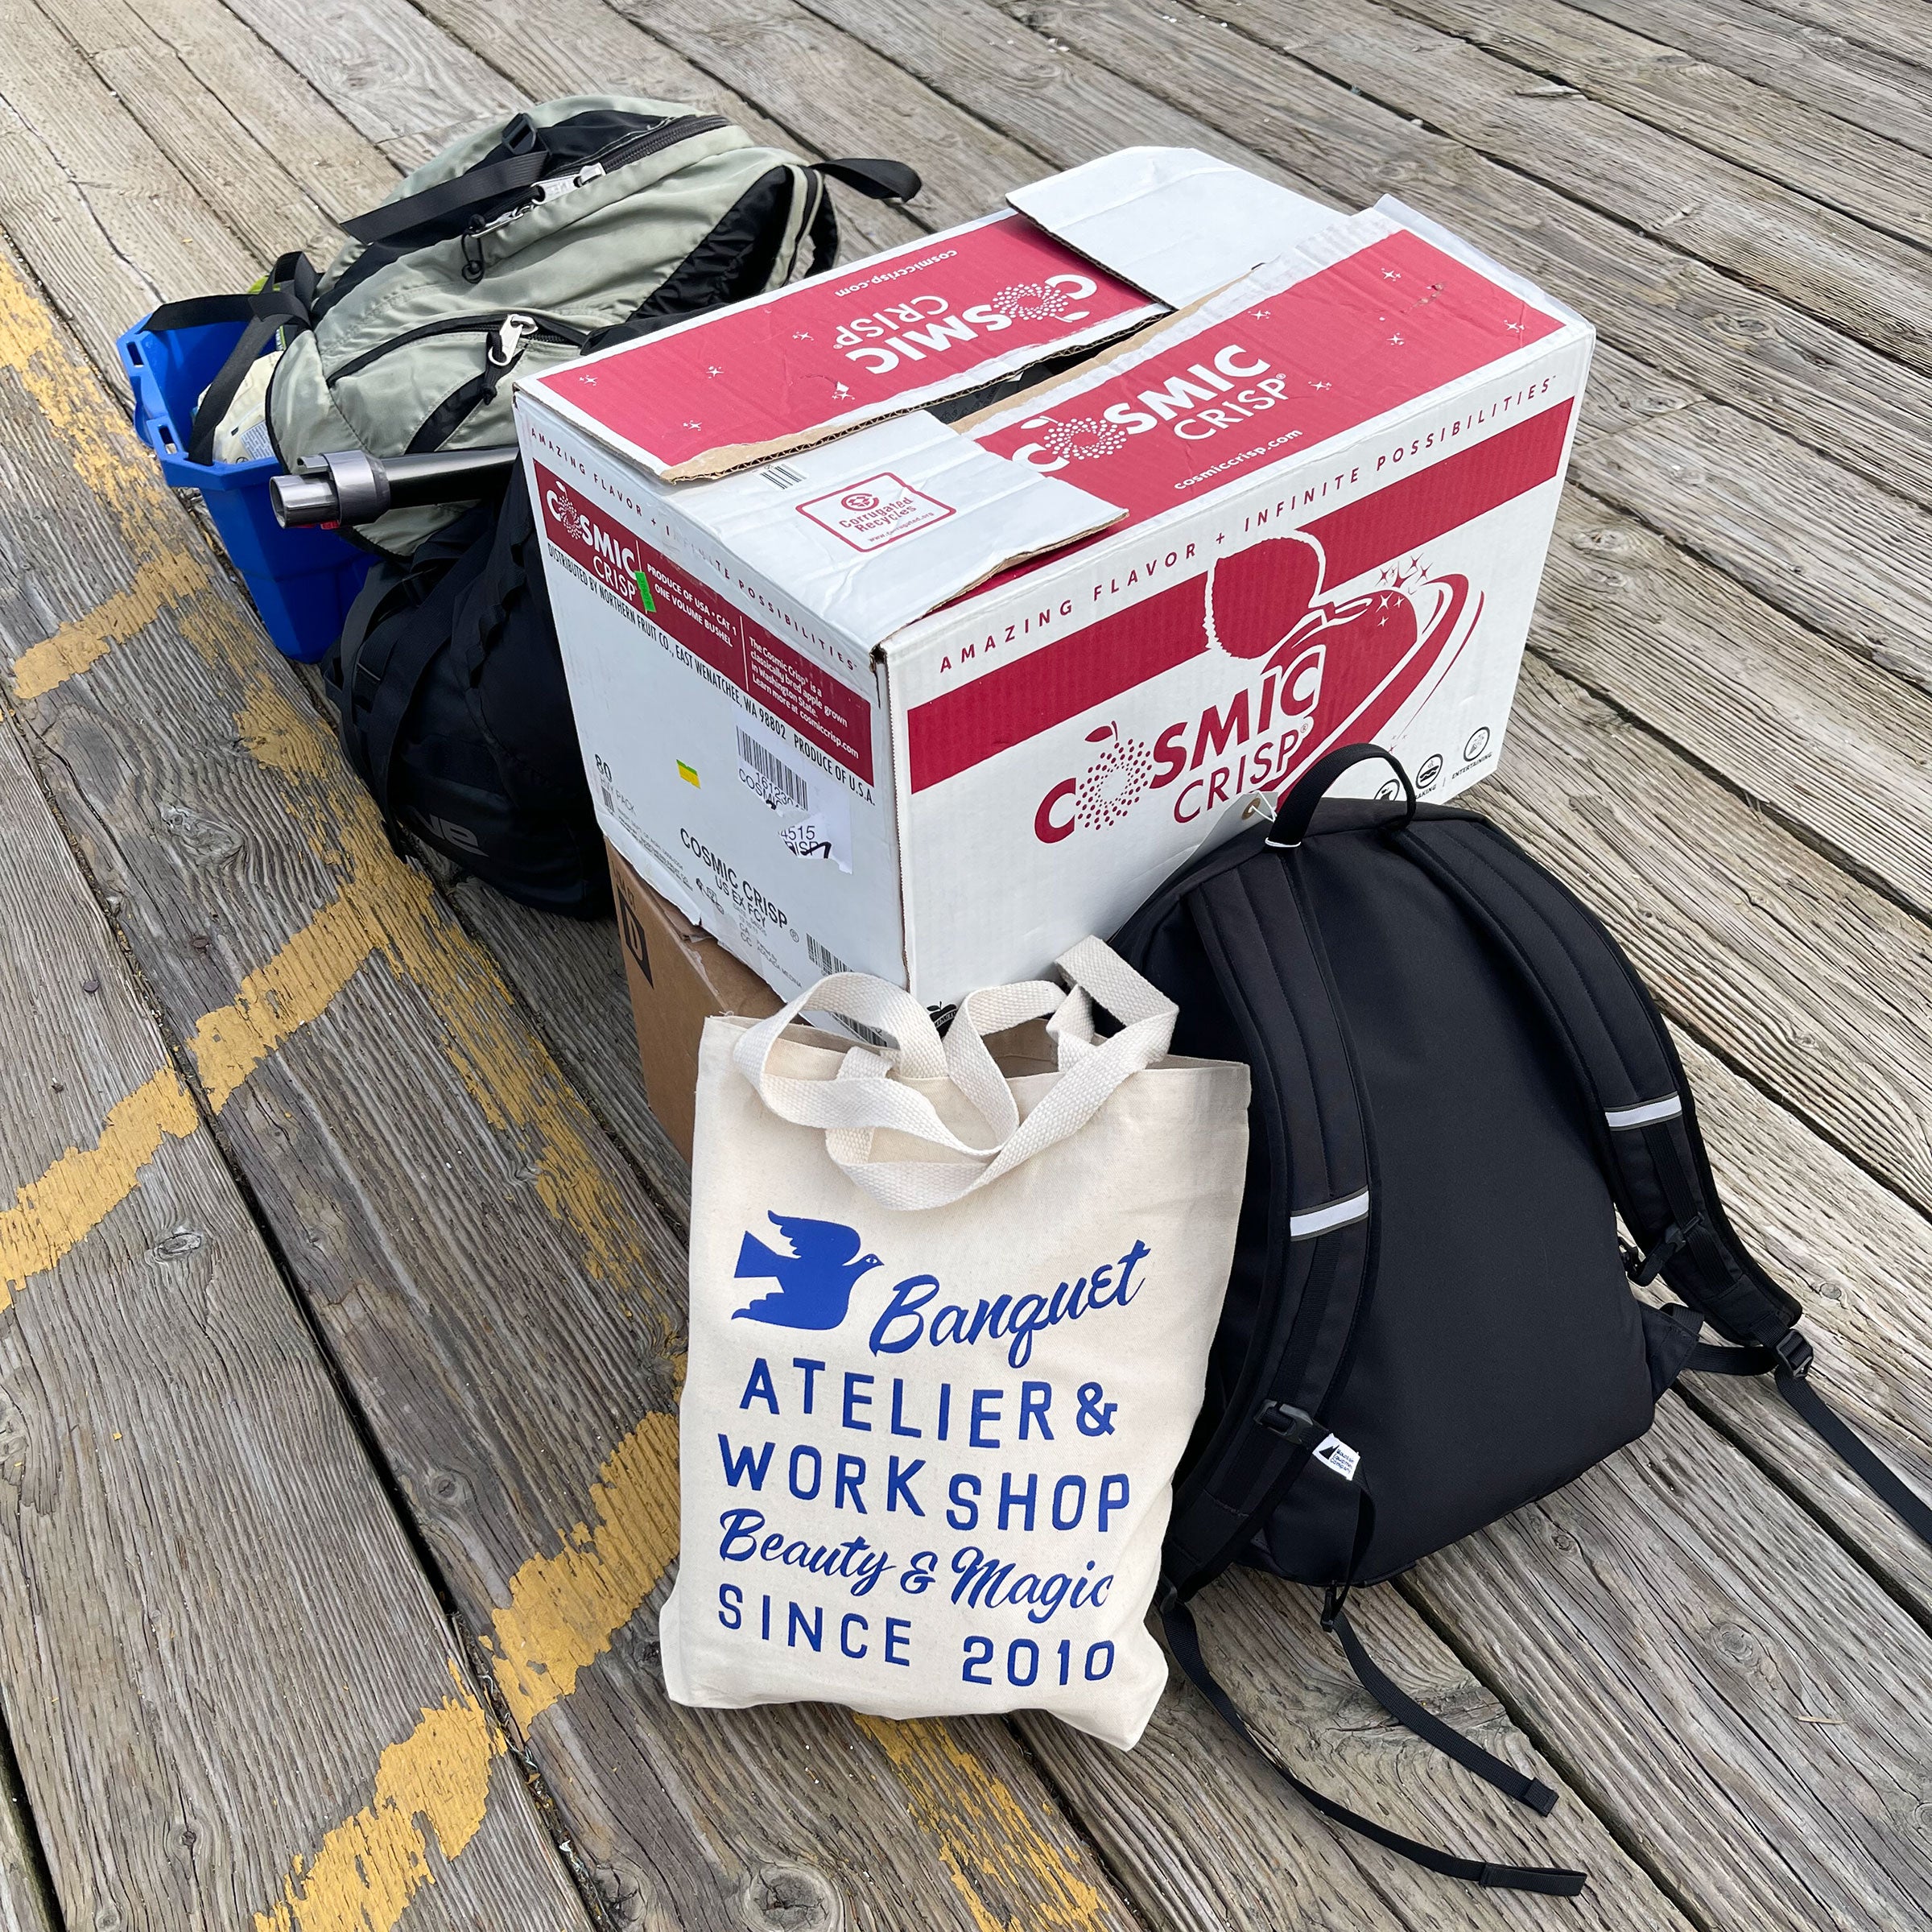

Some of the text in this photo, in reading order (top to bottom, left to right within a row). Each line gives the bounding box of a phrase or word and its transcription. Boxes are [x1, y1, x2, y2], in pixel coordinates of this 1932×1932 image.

[835, 250, 958, 297] cosmiccrisp.com
[845, 275, 1098, 374] COSMIC
[1012, 345, 1271, 473] COSMIC
[531, 427, 586, 476] AMAZING
[594, 473, 642, 517] FLAVOR
[1174, 429, 1303, 490] cosmiccrisp.com
[546, 488, 637, 580] COSMIC
[839, 497, 914, 528] Corrugated
[854, 506, 917, 532] Recycles
[647, 563, 737, 636] PRODUCE OF USA CAT 1
[939, 600, 1072, 673] AMAZING
[1093, 543, 1195, 601] FLAVOR
[1245, 468, 1359, 532] INFINITE
[654, 583, 733, 648] ONE VOLUME BUSHEL
[547, 543, 588, 586] DISTRIBUTED
[588, 576, 597, 594] BY
[599, 583, 636, 625] NORTHERN
[637, 615, 657, 641] FRUIT
[675, 646, 693, 670] EAST
[743, 696, 758, 718] WA
[759, 708, 786, 740] 98802
[794, 733, 832, 775] PRODUCE
[835, 766, 847, 785] OF
[848, 774, 876, 806] U.S.A.
[749, 636, 762, 653] The
[762, 647, 788, 671] Cosmic
[810, 680, 815, 694] is
[816, 688, 823, 697] a
[750, 650, 848, 727] classically bred apple grown
[751, 660, 758, 673] in
[758, 667, 798, 703] Washington
[753, 673, 859, 759] Learn more at cosmiccrisp.com
[1034, 650, 1321, 844] COSMIC
[595, 753, 612, 782] 80
[1451, 752, 1492, 779] ENTERTAINING
[680, 828, 738, 890] COSMIC
[742, 880, 788, 929] CRISP
[715, 875, 729, 896] US
[732, 889, 746, 910] EX
[748, 902, 766, 928] FCY
[869, 1238, 1152, 1368] Banquet
[739, 1357, 1118, 1449] ATELIER &
[717, 1433, 1129, 1533] WORKSHOP
[719, 1508, 1115, 1624] Beauty & Magic
[718, 1583, 1116, 1687] SINCE 2010
